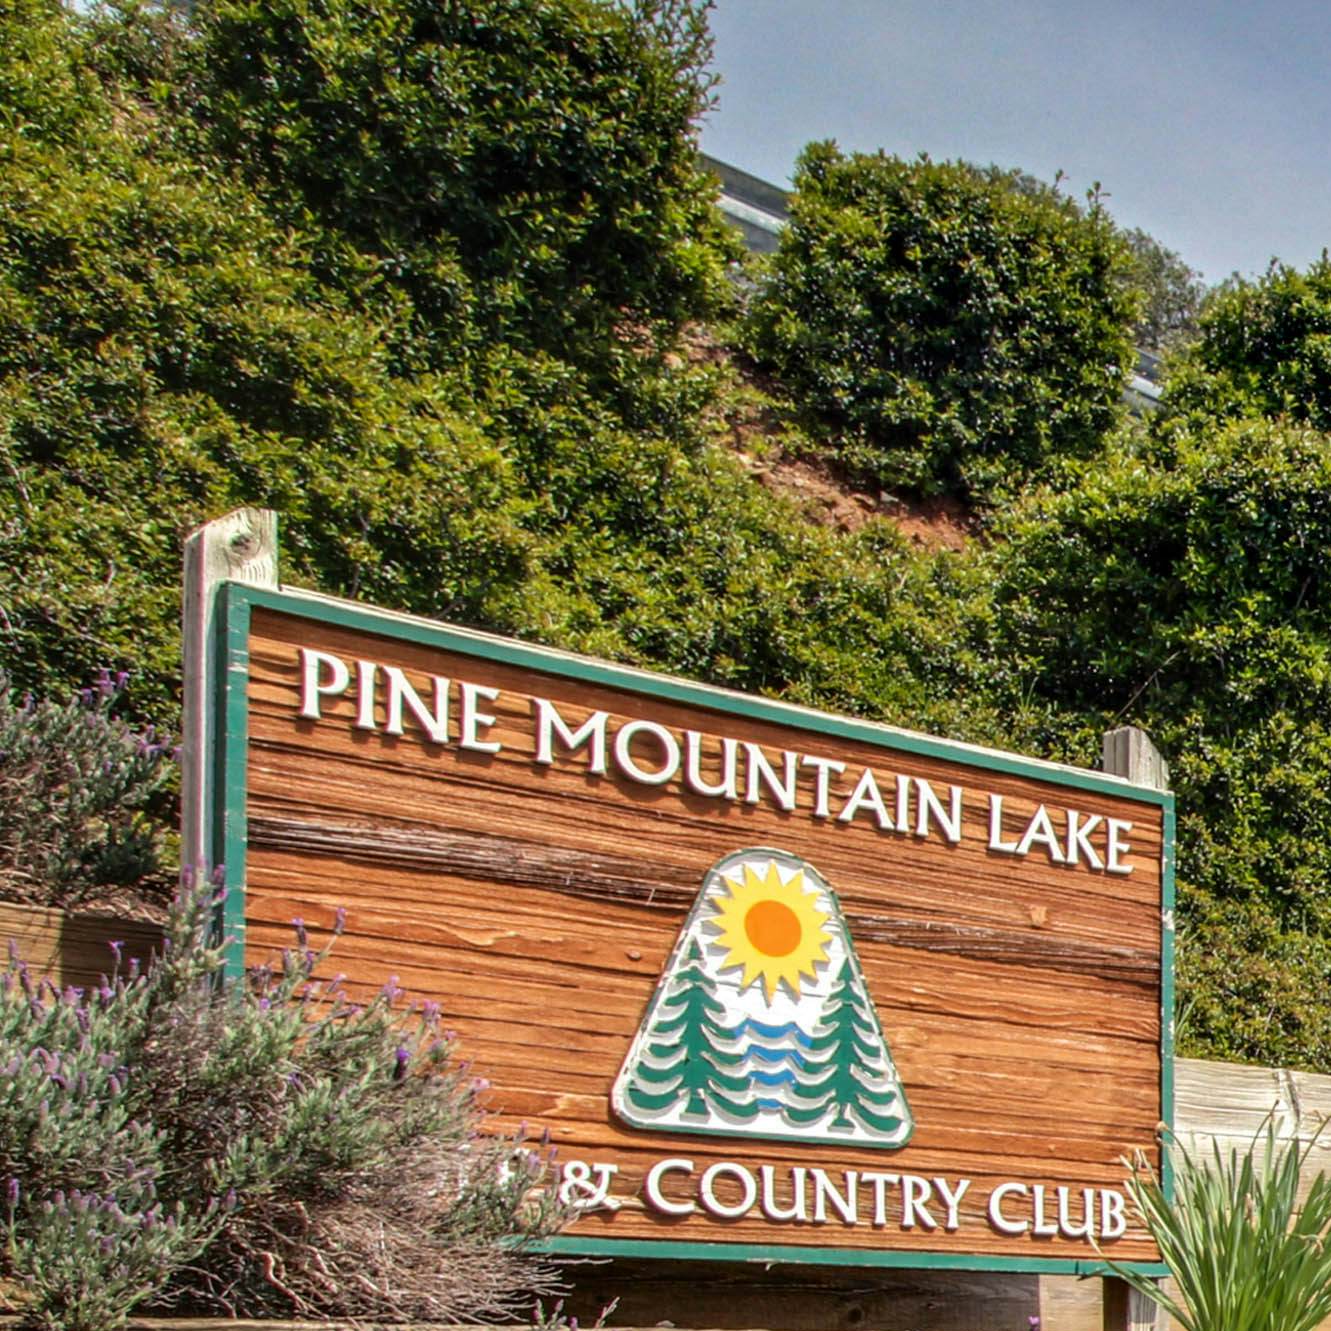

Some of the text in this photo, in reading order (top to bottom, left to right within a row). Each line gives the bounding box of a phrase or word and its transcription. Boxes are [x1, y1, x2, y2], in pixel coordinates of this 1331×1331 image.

[300, 647, 1135, 875] PINE MOUNTAIN LAKE
[559, 1160, 622, 1211] &
[643, 1158, 970, 1231] COUNTRY
[986, 1182, 1128, 1239] CLUB
